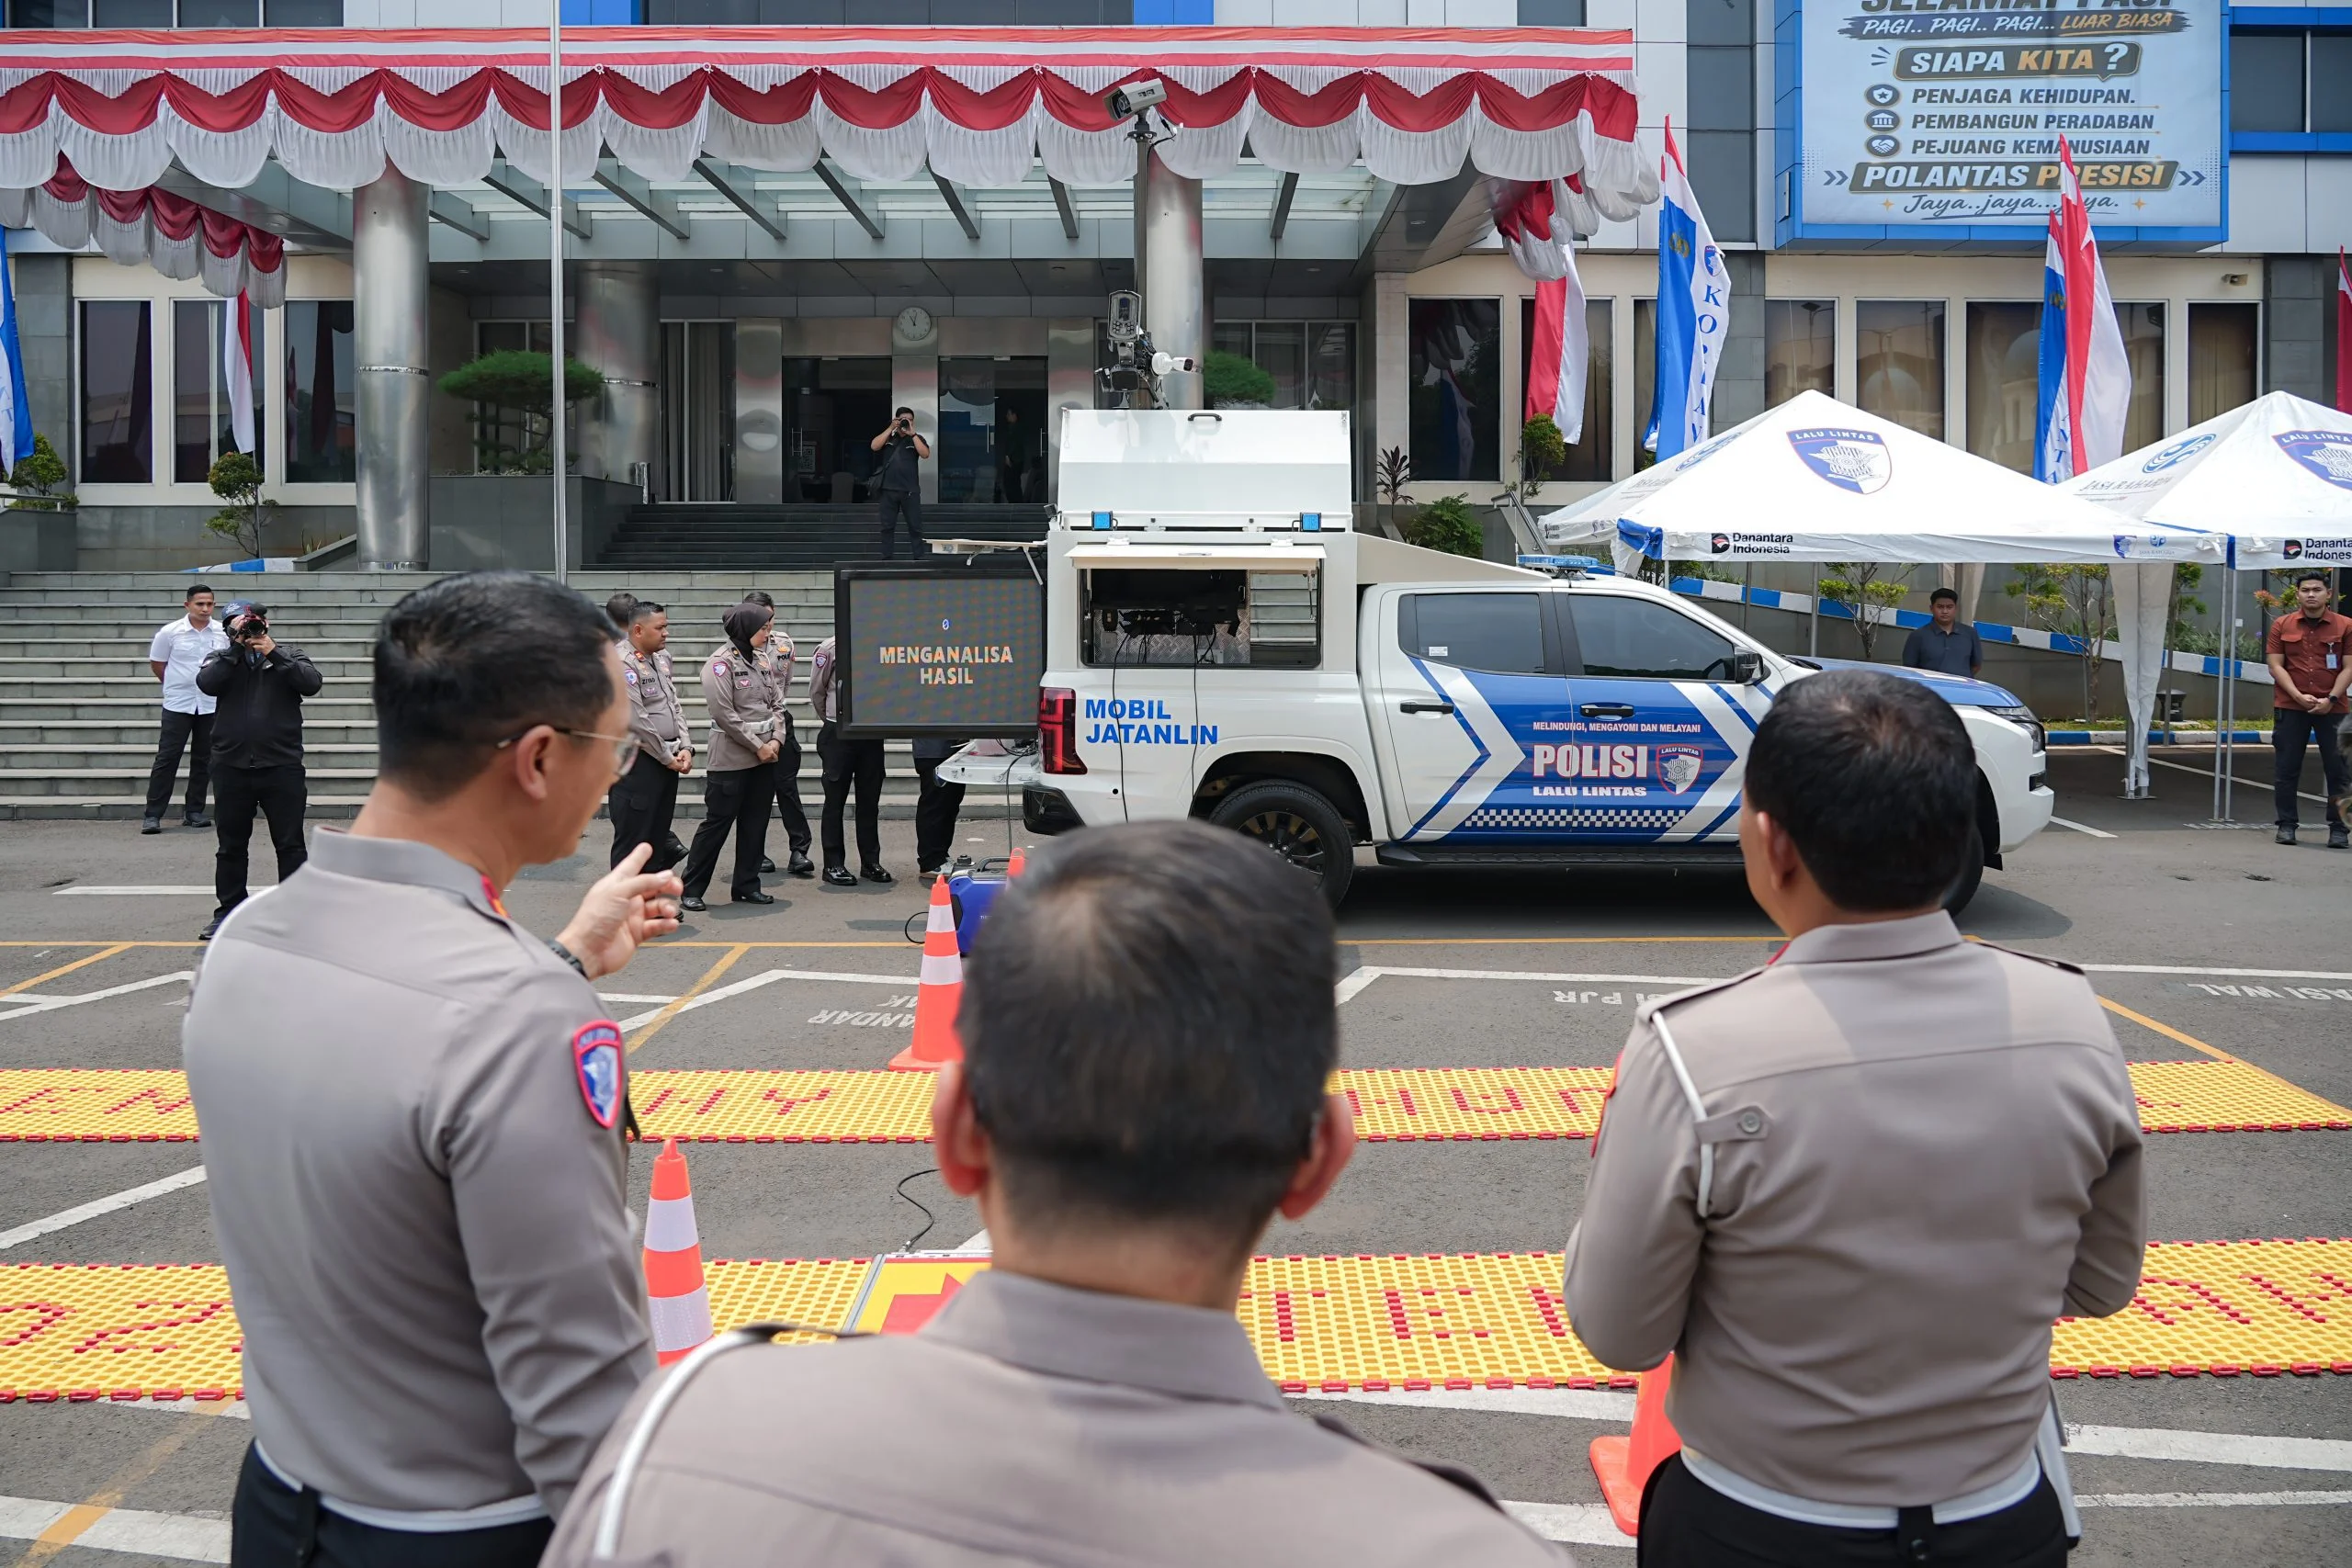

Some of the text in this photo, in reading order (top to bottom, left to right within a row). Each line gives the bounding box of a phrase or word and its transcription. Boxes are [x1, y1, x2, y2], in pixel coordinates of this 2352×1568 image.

[2060, 14, 2112, 29] LUAR
[2115, 12, 2174, 28] BIASA
[1910, 51, 2005, 73] SIAPA
[2017, 49, 2094, 71] KITA
[1911, 88, 2135, 104] PENJAGA KEHIDUPAN.
[1911, 114, 2154, 130] PEMBANGUN PERADABAN
[1911, 139, 2007, 154] PEJUANG
[1862, 165, 2030, 187] POLANTAS
[1795, 430, 1874, 441] LALU LINTAS
[2281, 433, 2352, 443] LALU LINTA
[1732, 532, 1793, 543] Danantara
[1733, 544, 1791, 554] Indonesia
[879, 646, 1014, 664] MENGANALISA
[920, 667, 974, 685] HASIL
[1085, 699, 1171, 719] MOBIL
[1085, 724, 1218, 745] JATANLIN
[1532, 721, 1701, 733] MELINDUNGI, MENGAYOMI DAN MELAYANI
[1678, 747, 1700, 756] LINTAS
[1532, 744, 1648, 778] POLISI
[1532, 785, 1647, 796] LALU LINTAS
[807, 1010, 916, 1029] ANDAR
